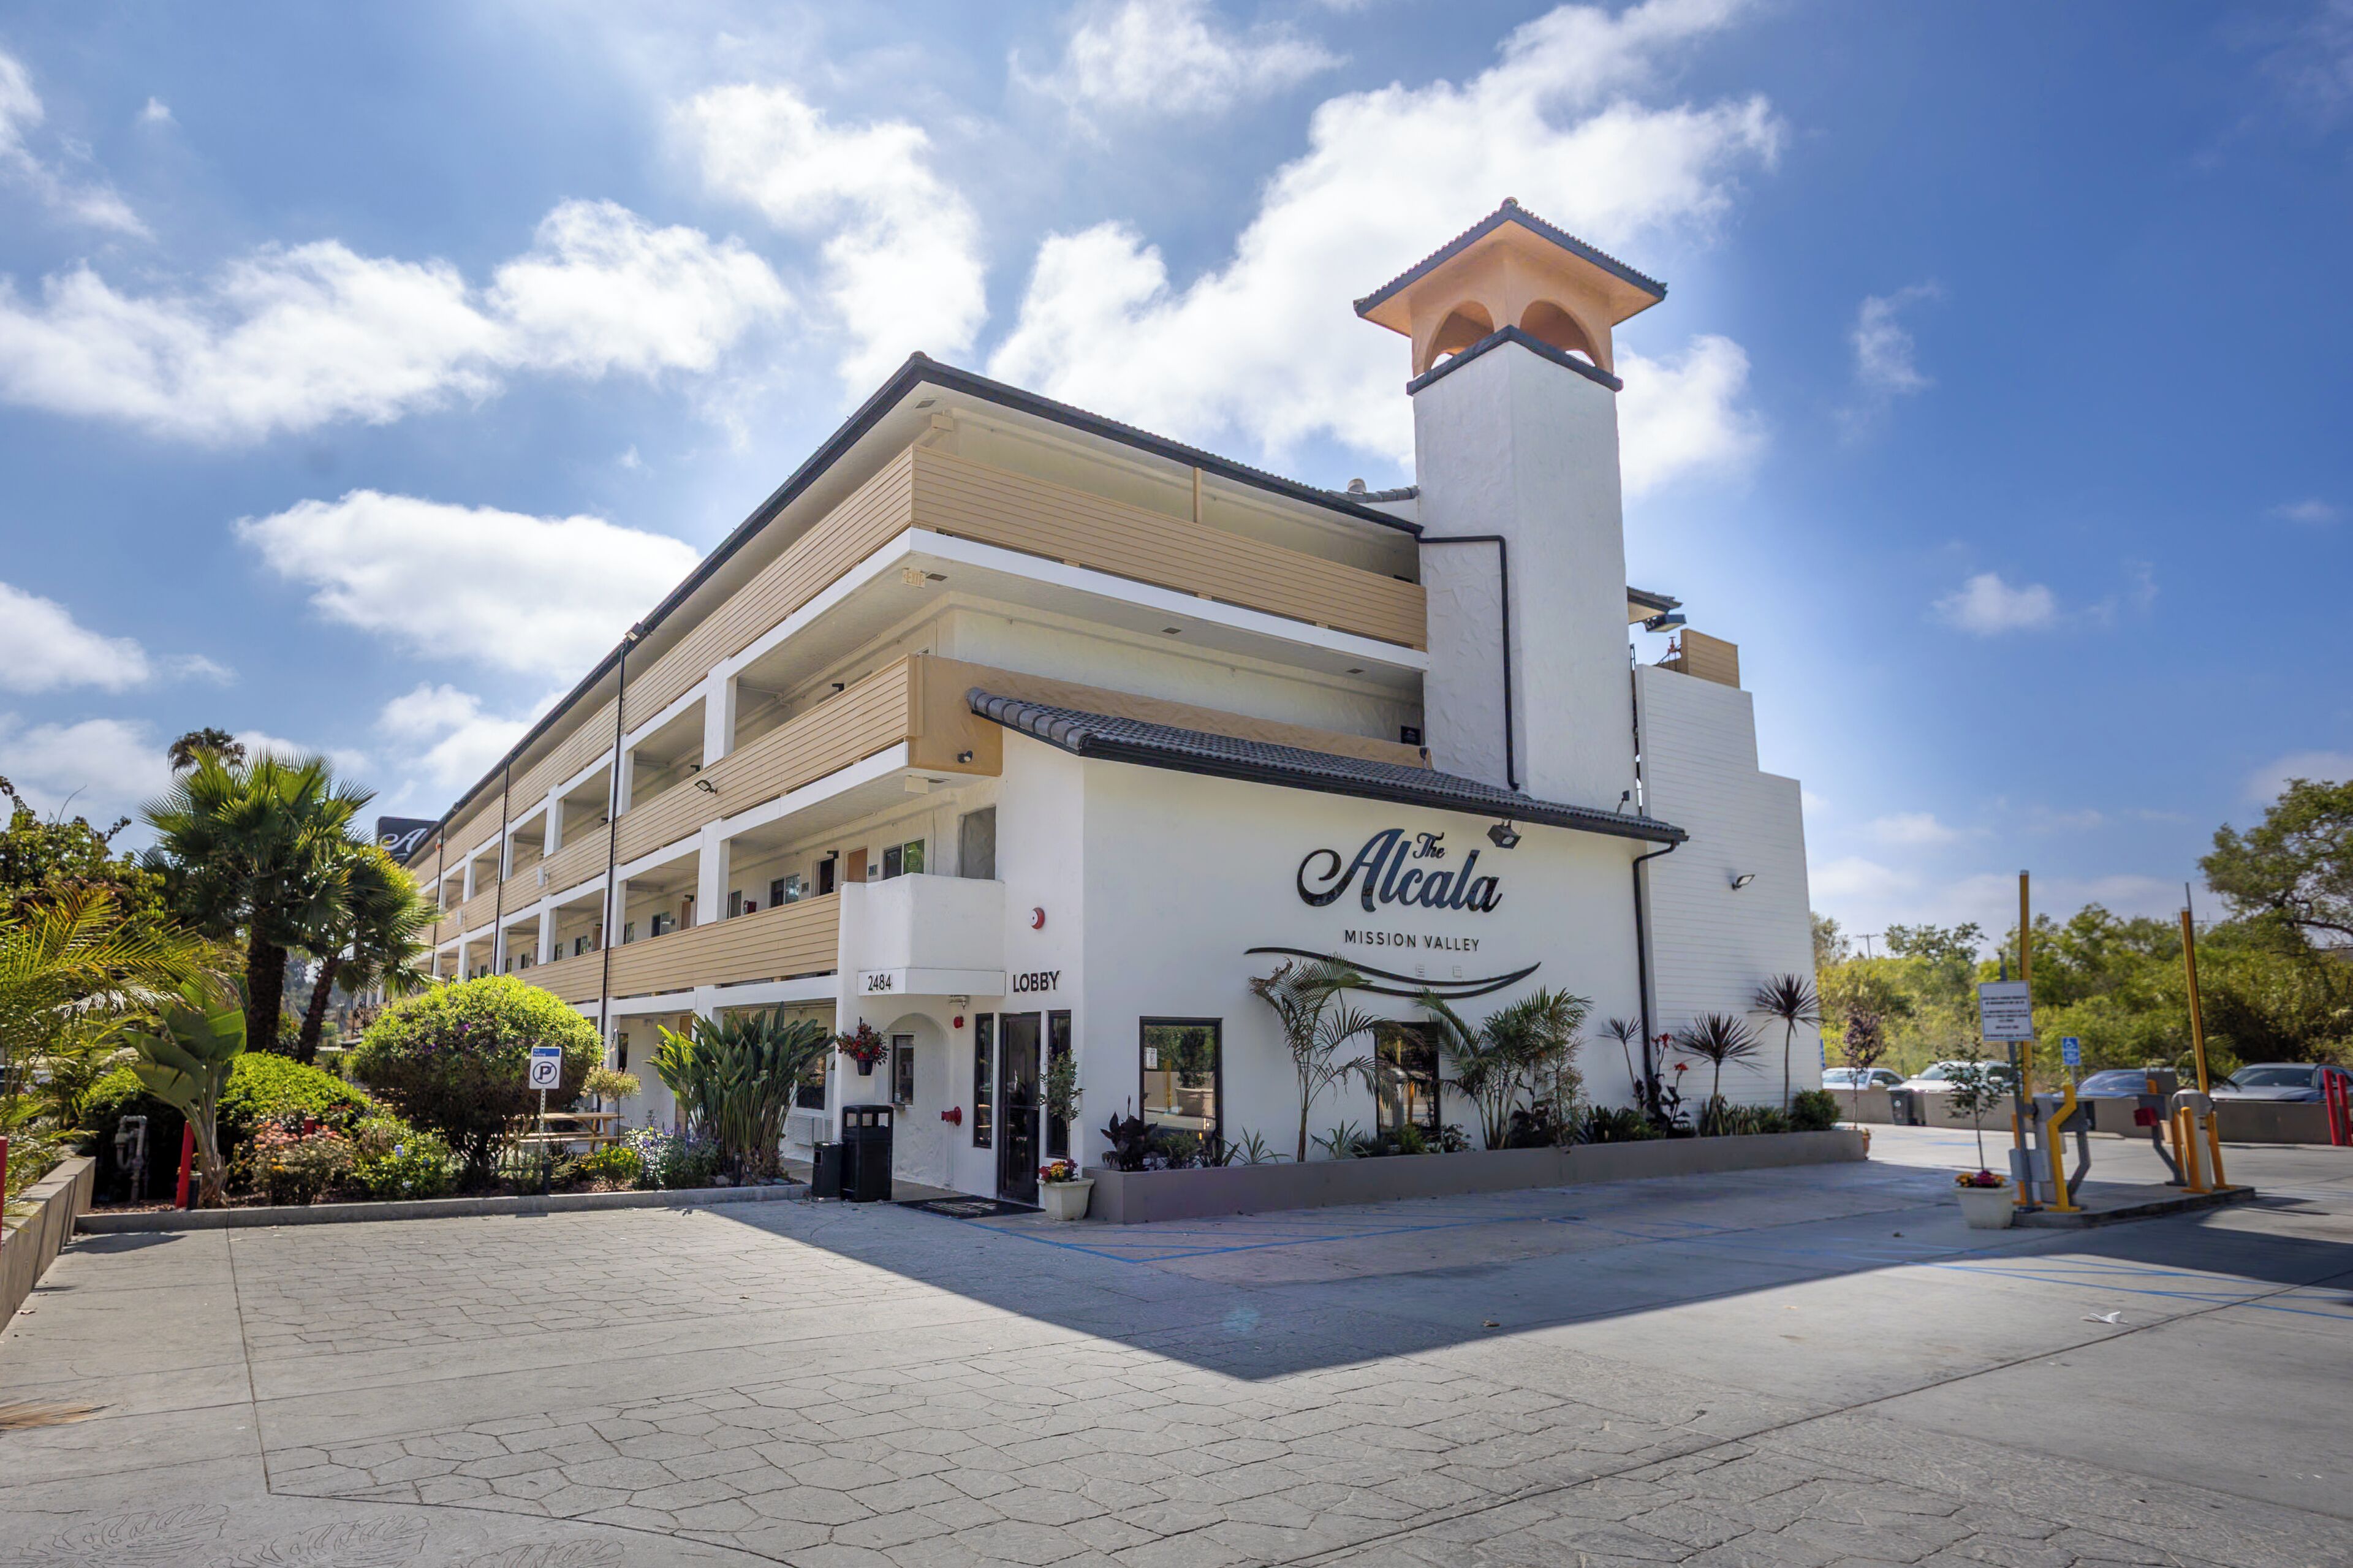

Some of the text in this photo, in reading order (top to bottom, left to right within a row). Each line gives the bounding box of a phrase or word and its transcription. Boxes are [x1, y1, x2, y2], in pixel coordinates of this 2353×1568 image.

[1412, 832, 1446, 858] The
[1297, 828, 1503, 913] Alcala
[1345, 930, 1479, 951] MISSION VALLEY
[868, 974, 892, 991] 2484
[1013, 970, 1061, 993] LOBBY
